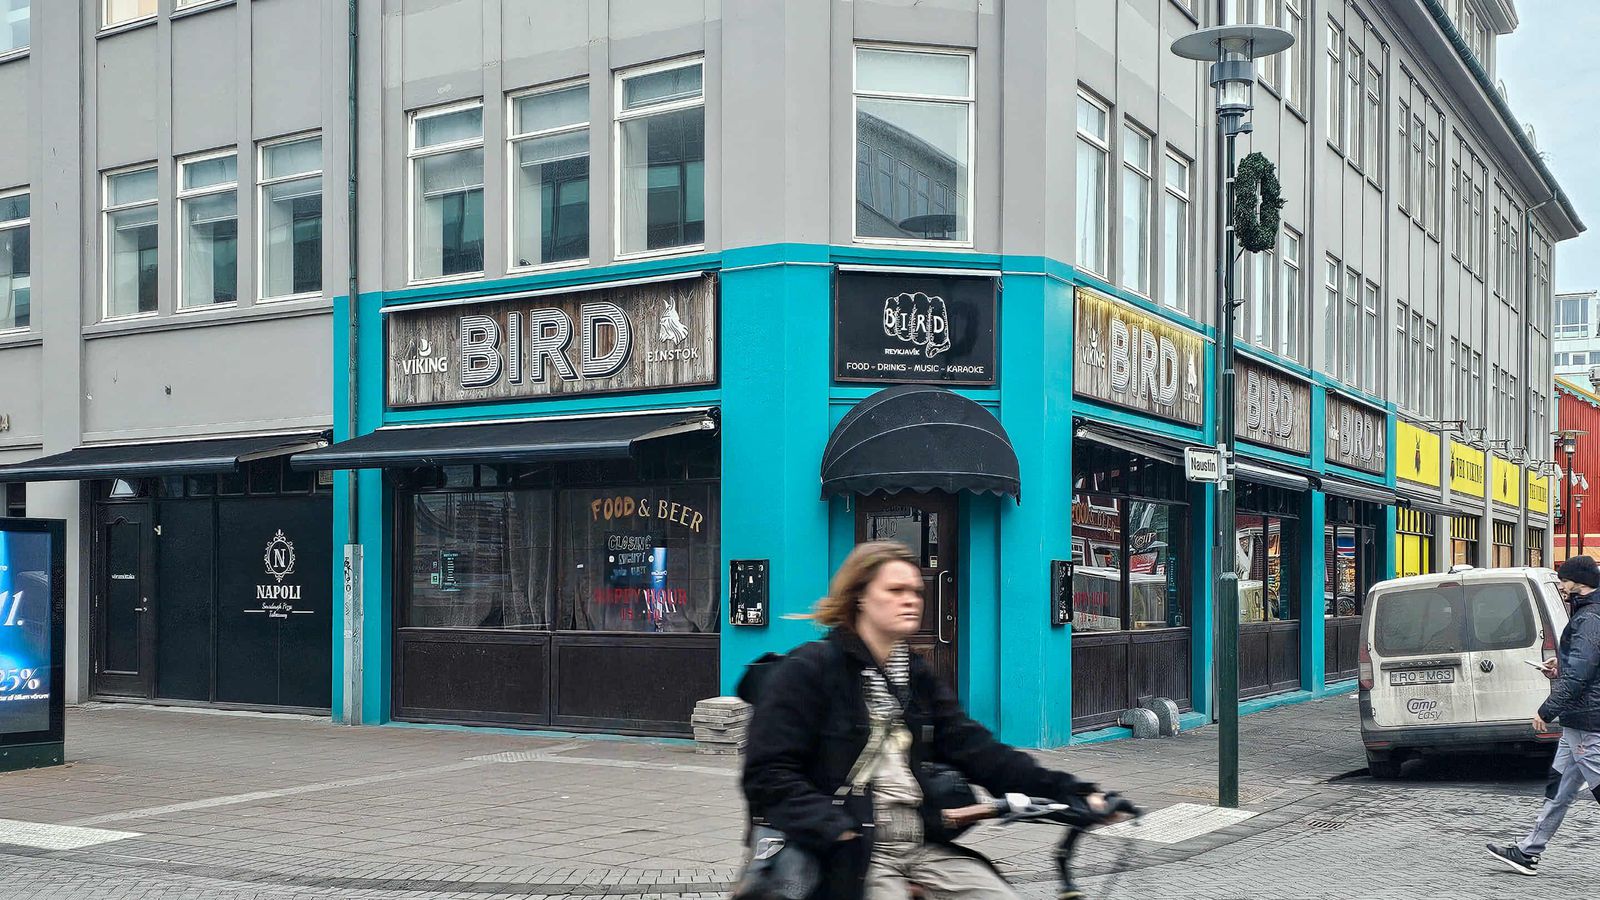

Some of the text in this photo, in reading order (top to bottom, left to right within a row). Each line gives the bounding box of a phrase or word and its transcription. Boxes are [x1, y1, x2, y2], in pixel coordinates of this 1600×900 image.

[884, 308, 945, 334] BIRD
[460, 301, 635, 389] BIRD
[846, 362, 870, 371] FOOD
[877, 363, 907, 372] DRINKS
[913, 364, 940, 373] MUSIC
[946, 364, 985, 374] KARAOKE
[1110, 316, 1179, 407] BIRD
[1246, 369, 1294, 440] BIRD
[1340, 403, 1374, 463] BIRD
[1190, 457, 1217, 472] Naustin
[1456, 457, 1465, 479] THE
[591, 496, 704, 533] FOOD & BEER
[273, 548, 286, 568] N
[256, 585, 301, 600] NAPOLI
[1399, 671, 1417, 683] RO
[1426, 670, 1451, 681] M63
[1407, 698, 1437, 715] Camp
[1418, 709, 1443, 721] Easy
